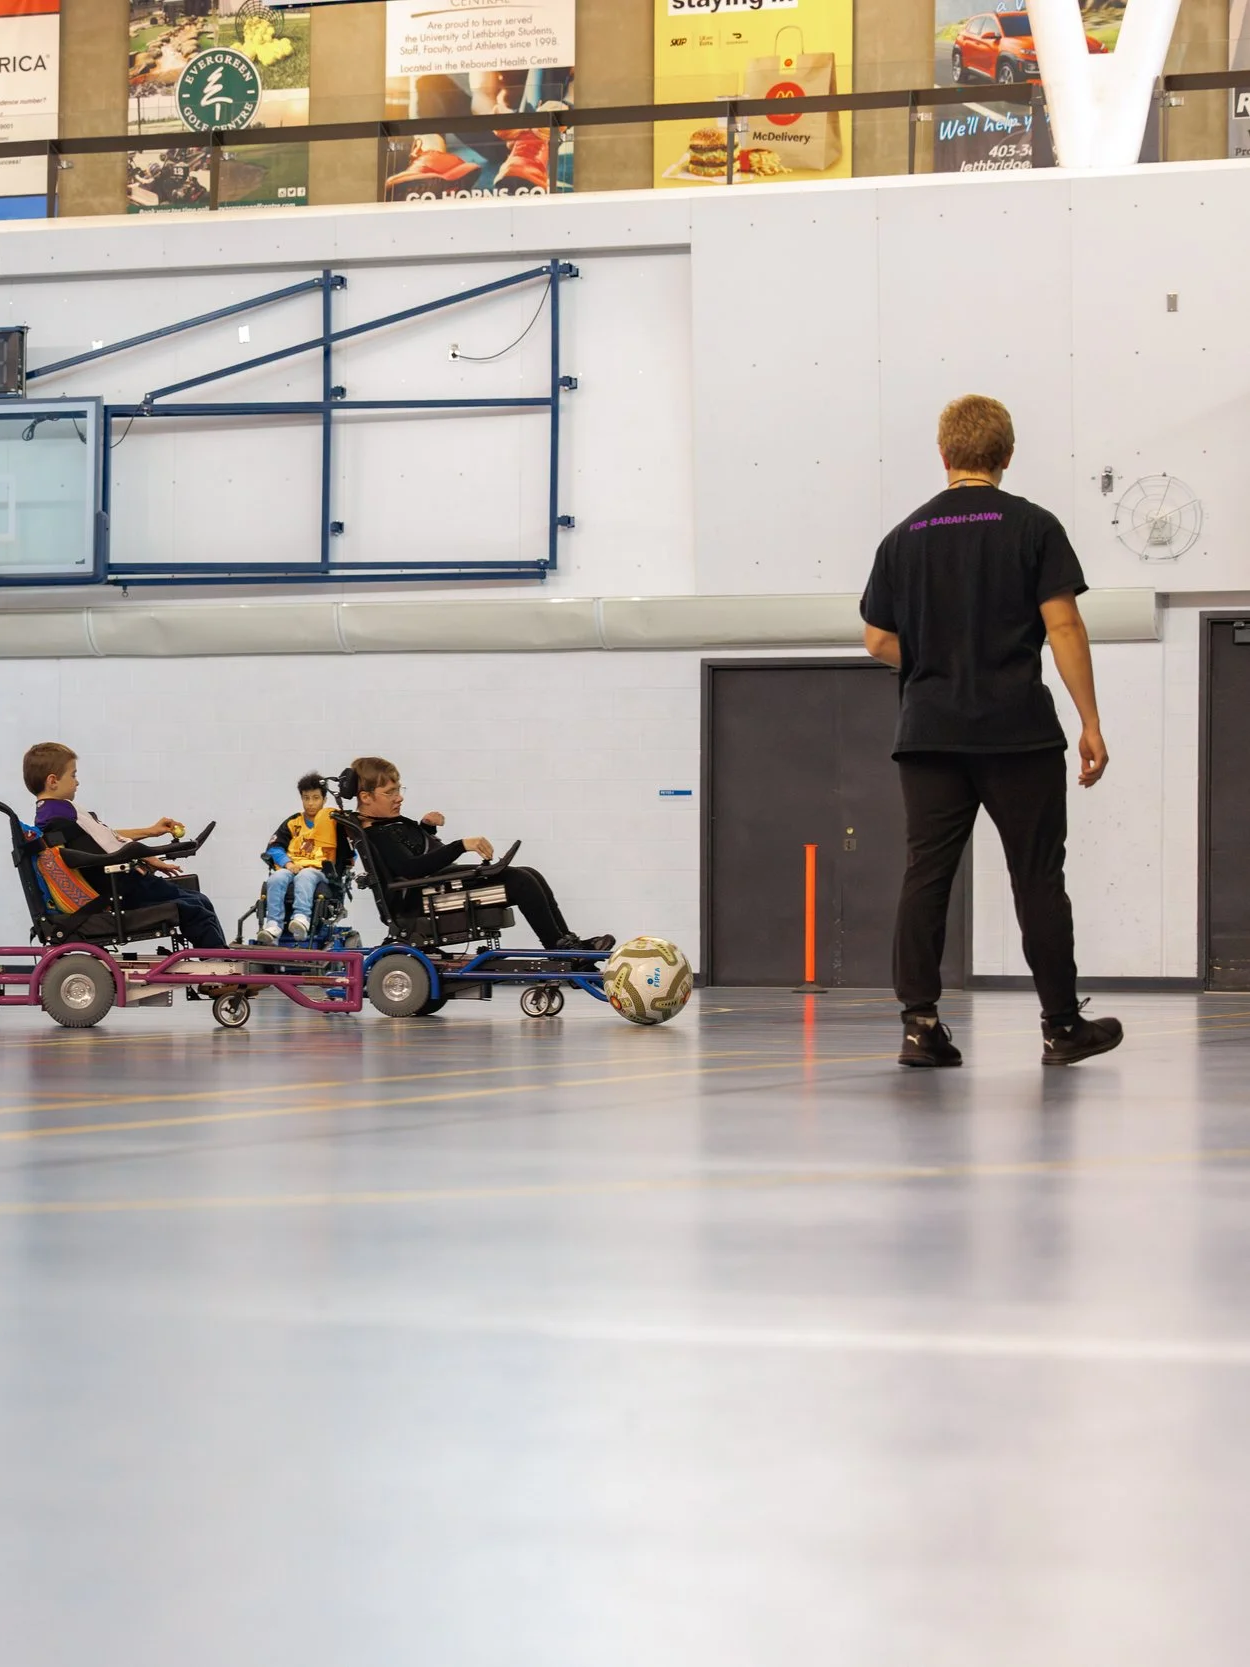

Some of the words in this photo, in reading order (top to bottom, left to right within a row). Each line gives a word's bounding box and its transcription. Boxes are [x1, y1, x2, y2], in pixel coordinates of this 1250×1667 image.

[427, 21, 442, 29] Are
[445, 19, 469, 30] proud
[471, 19, 480, 28] to
[482, 17, 502, 26] have
[505, 14, 533, 24] served
[405, 35, 417, 43] the
[420, 31, 459, 43] University
[462, 30, 470, 40] of
[472, 28, 515, 39] Lethbridge
[670, 37, 688, 47] SKIP
[456, 43, 473, 52] and
[475, 40, 507, 50] Athletes
[509, 38, 531, 48] since
[184, 54, 254, 86] EVERGREEN
[400, 63, 432, 73] Located
[435, 63, 442, 71] in
[445, 61, 458, 70] the
[460, 58, 497, 69] Rebound
[500, 57, 528, 67] Health
[530, 56, 558, 65] Centre
[183, 106, 209, 131] GOLF
[212, 101, 254, 131] CENTRE
[940, 115, 979, 140] We'll
[984, 112, 1023, 133] help
[752, 131, 810, 145] McDelivery
[909, 520, 928, 532] FOR
[930, 512, 1003, 527] SARAH-DAWN
[653, 967, 661, 988] FIPFA
